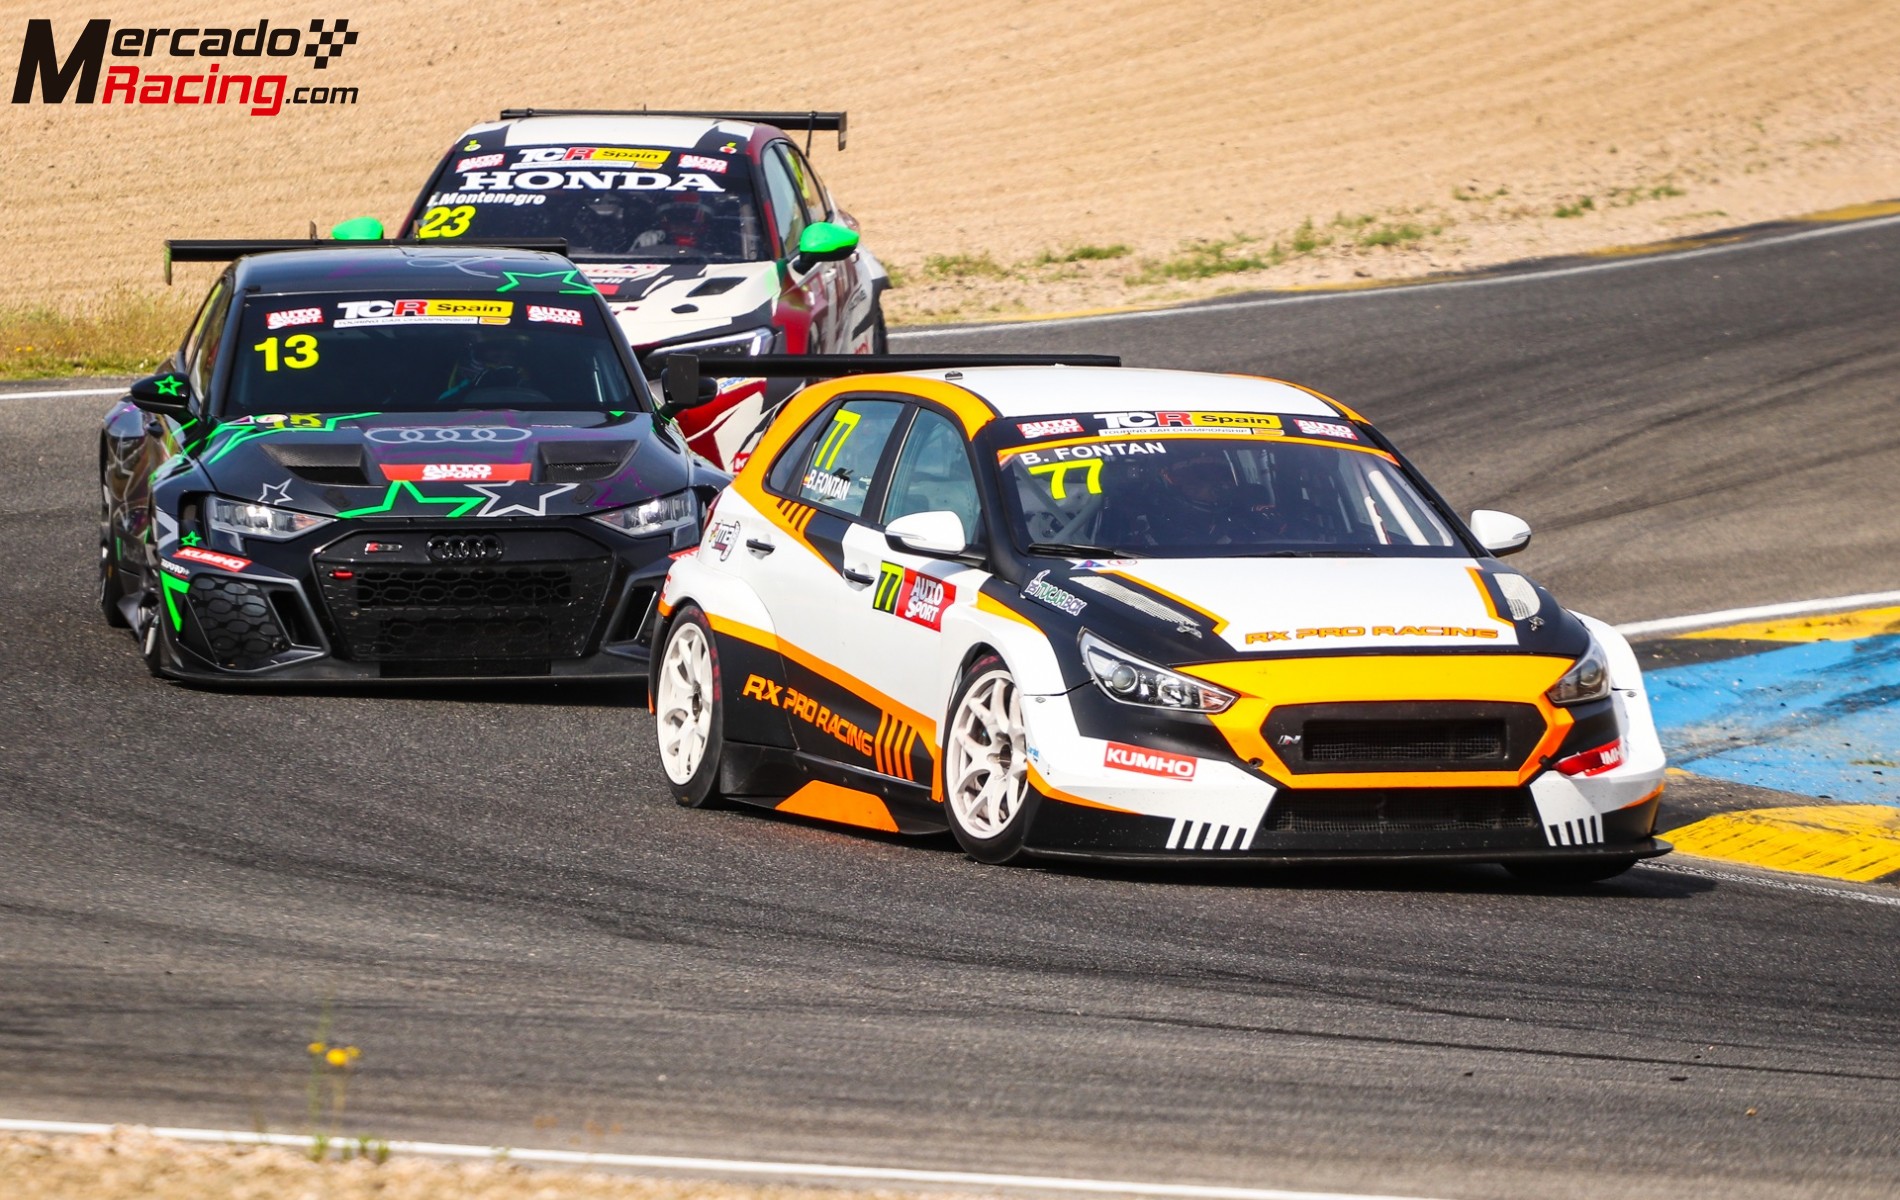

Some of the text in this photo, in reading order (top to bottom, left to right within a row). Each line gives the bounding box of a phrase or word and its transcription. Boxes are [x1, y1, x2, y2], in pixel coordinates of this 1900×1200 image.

[518, 147, 659, 163] TCR Spain
[459, 171, 726, 193] HONDA
[418, 204, 477, 239] 23
[268, 308, 321, 320] AUTO
[337, 300, 502, 319] TCR Spain
[528, 305, 581, 318] AUTO
[253, 334, 320, 371] 13
[1020, 419, 1077, 432] AUTO
[1093, 411, 1271, 429] TCR Spain
[1298, 419, 1352, 433] AUTO
[814, 409, 861, 470] 77
[1019, 441, 1167, 465] B. FONTAN
[421, 464, 492, 474] AUTO
[1027, 457, 1104, 500] 77
[806, 469, 851, 501] B.FONTAN
[179, 548, 246, 569] KUMHO
[874, 560, 905, 612] 77
[910, 575, 944, 606] AUTO
[904, 596, 940, 623] SPORT
[1245, 625, 1499, 645] RX PRO RACING
[742, 673, 784, 707] RX
[782, 687, 818, 723] PRO
[815, 705, 874, 757] RACING
[1106, 747, 1195, 777] KUMHO
